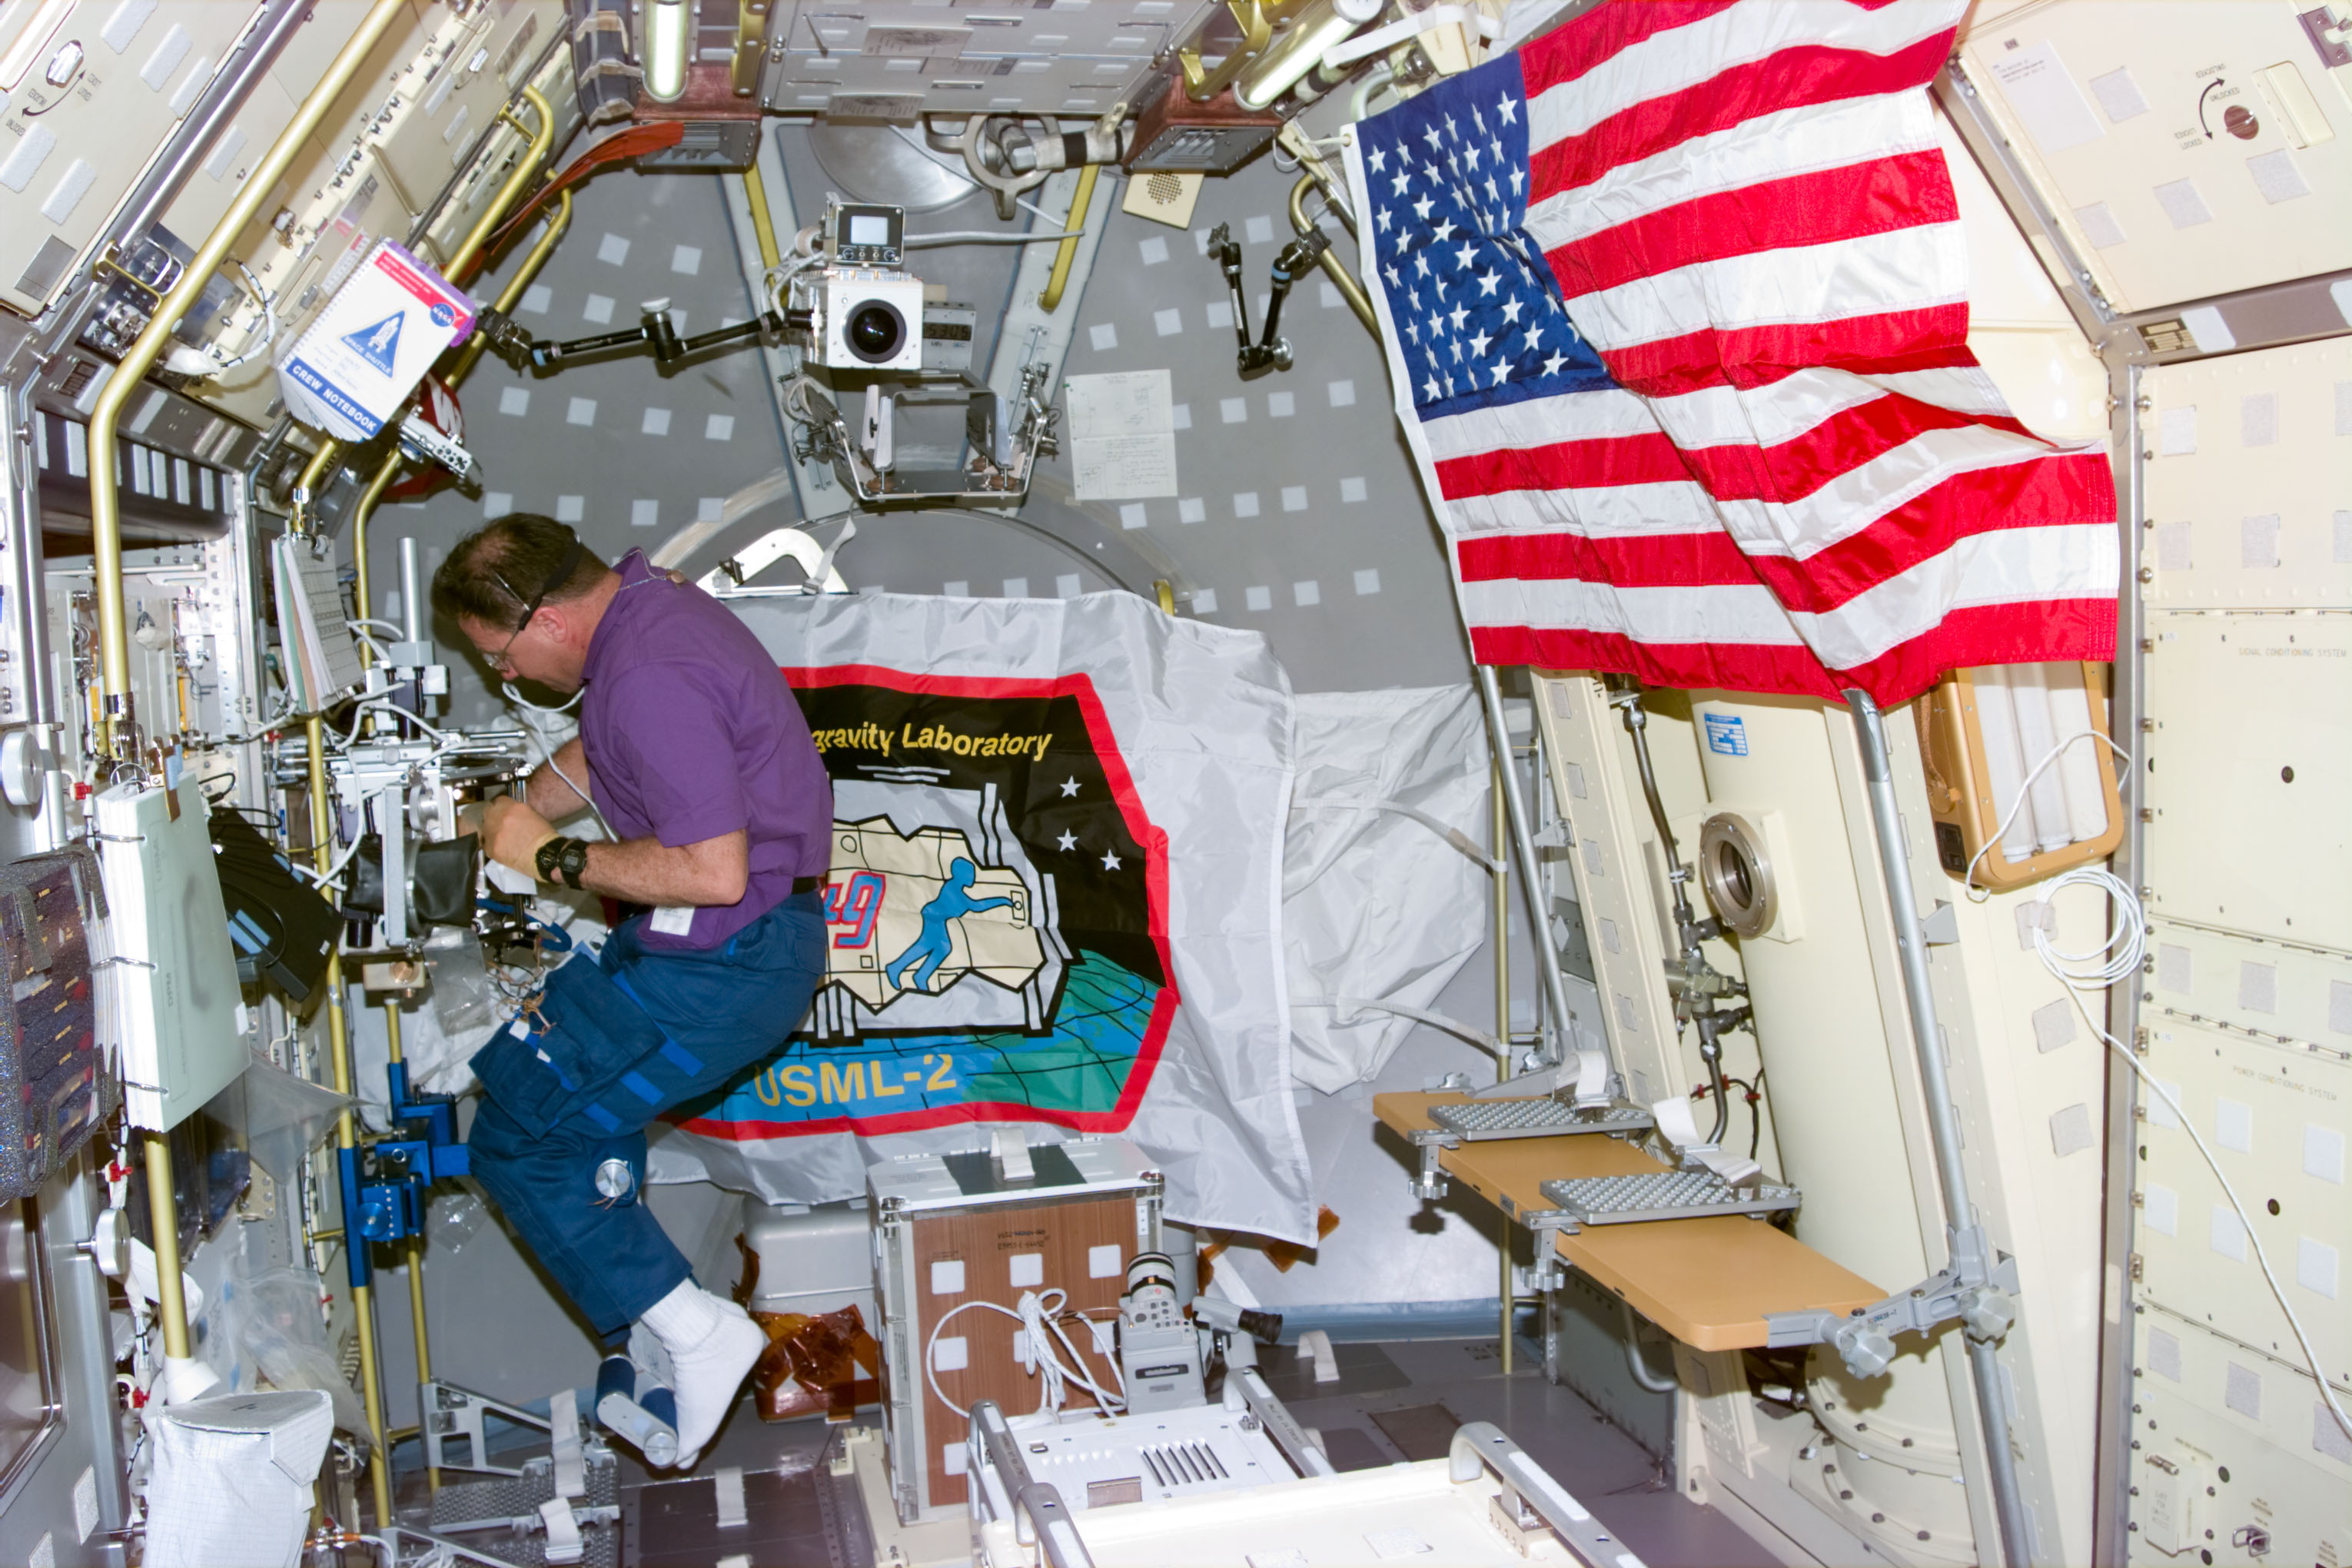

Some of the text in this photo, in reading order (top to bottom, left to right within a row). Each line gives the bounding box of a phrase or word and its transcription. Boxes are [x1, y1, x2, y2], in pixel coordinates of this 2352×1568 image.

[432, 307, 452, 324] NASA
[344, 336, 365, 355] SPACE
[364, 350, 391, 374] SHUTTLE
[292, 365, 324, 390] CREW
[323, 389, 377, 432] NOTEBOOK
[2318, 648, 2347, 658] SYSTEM
[811, 721, 1053, 762] gravity Laboratory
[754, 1054, 957, 1107] USML-2
